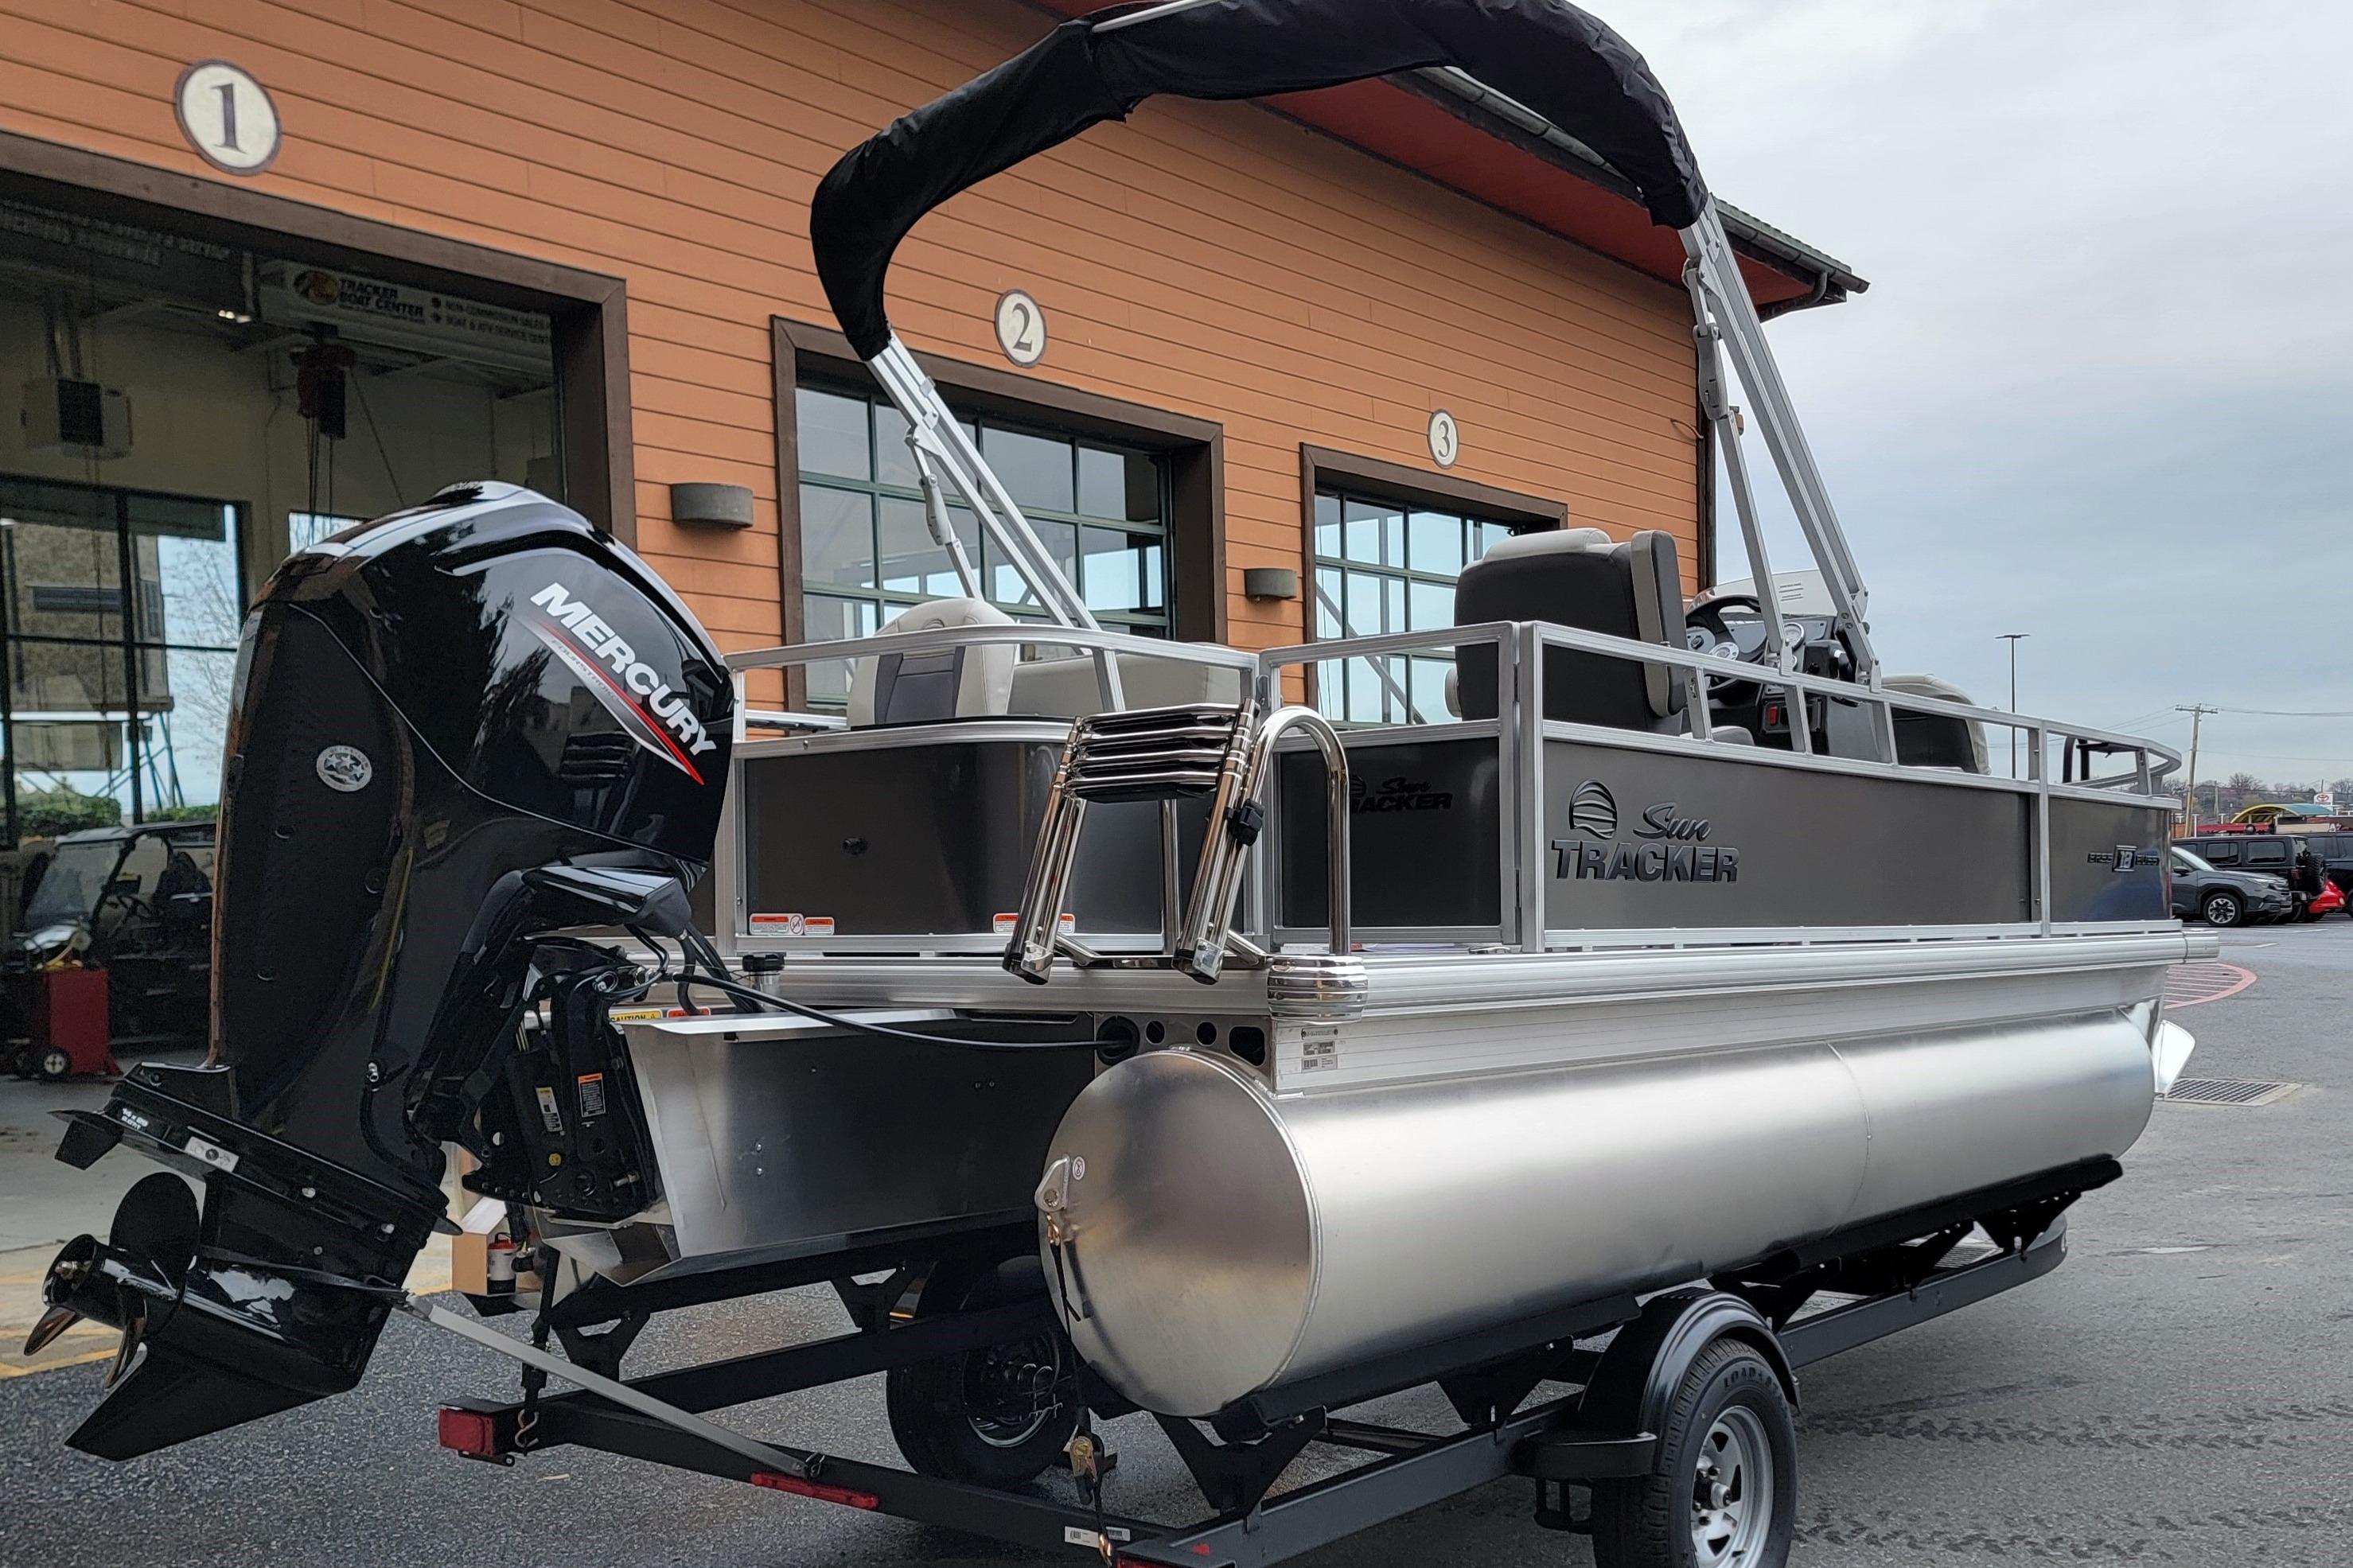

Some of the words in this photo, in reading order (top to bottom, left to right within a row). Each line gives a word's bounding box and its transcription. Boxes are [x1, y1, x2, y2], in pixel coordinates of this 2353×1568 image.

[210, 82, 248, 155] 1
[340, 278, 398, 298] TRACKER
[340, 291, 371, 305] BOAT
[375, 298, 424, 317] CENTER
[1012, 302, 1033, 352] 2
[1438, 420, 1451, 457] 3
[530, 582, 717, 756] MERCURY
[1350, 792, 1454, 812] ACKER
[1375, 776, 1432, 795] Sun
[1633, 802, 1711, 841] Sun
[1552, 839, 1740, 883] TRACKER
